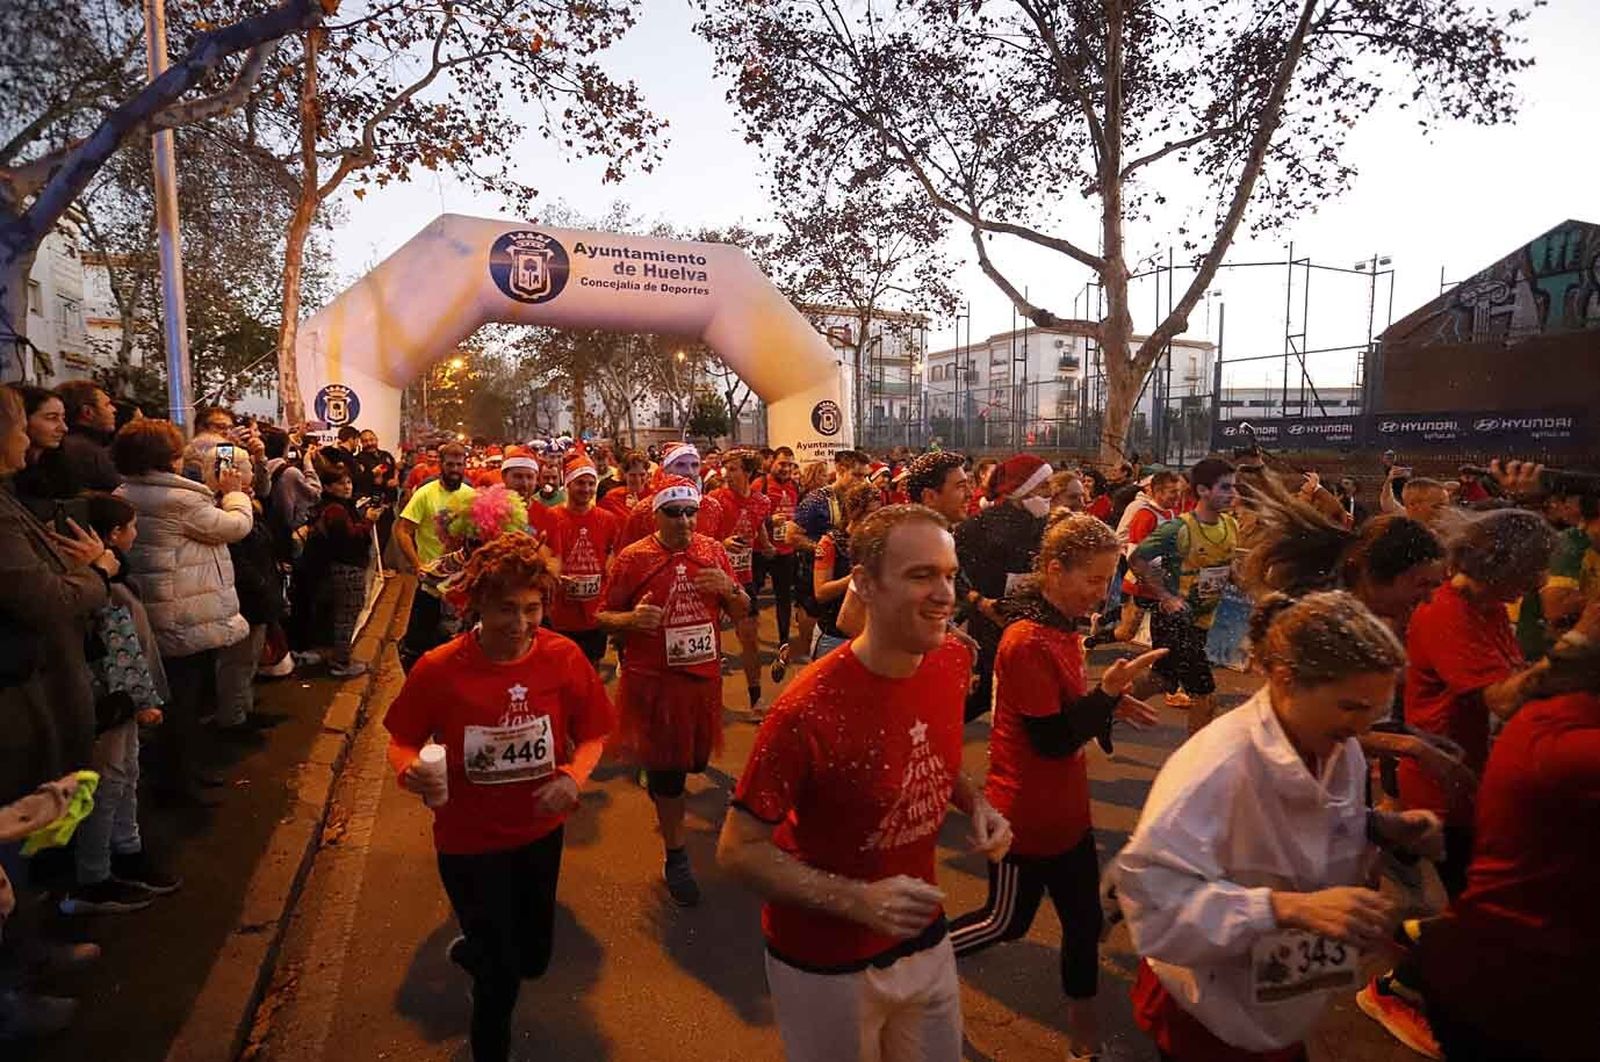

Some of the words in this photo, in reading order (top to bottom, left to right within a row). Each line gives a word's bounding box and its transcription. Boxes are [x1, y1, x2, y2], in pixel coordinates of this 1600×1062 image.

[574, 242, 706, 265] Ayuntamiento
[613, 261, 637, 276] de
[643, 263, 707, 281] Huelva
[643, 282, 657, 291] de
[660, 283, 709, 295] Deportes
[1306, 424, 1353, 434] HYUNDAI
[1400, 421, 1457, 431] HYUNDAI
[1501, 417, 1572, 429] HYUNDAI
[688, 636, 712, 653] 342
[502, 739, 546, 763] 446
[1298, 937, 1346, 973] 343
